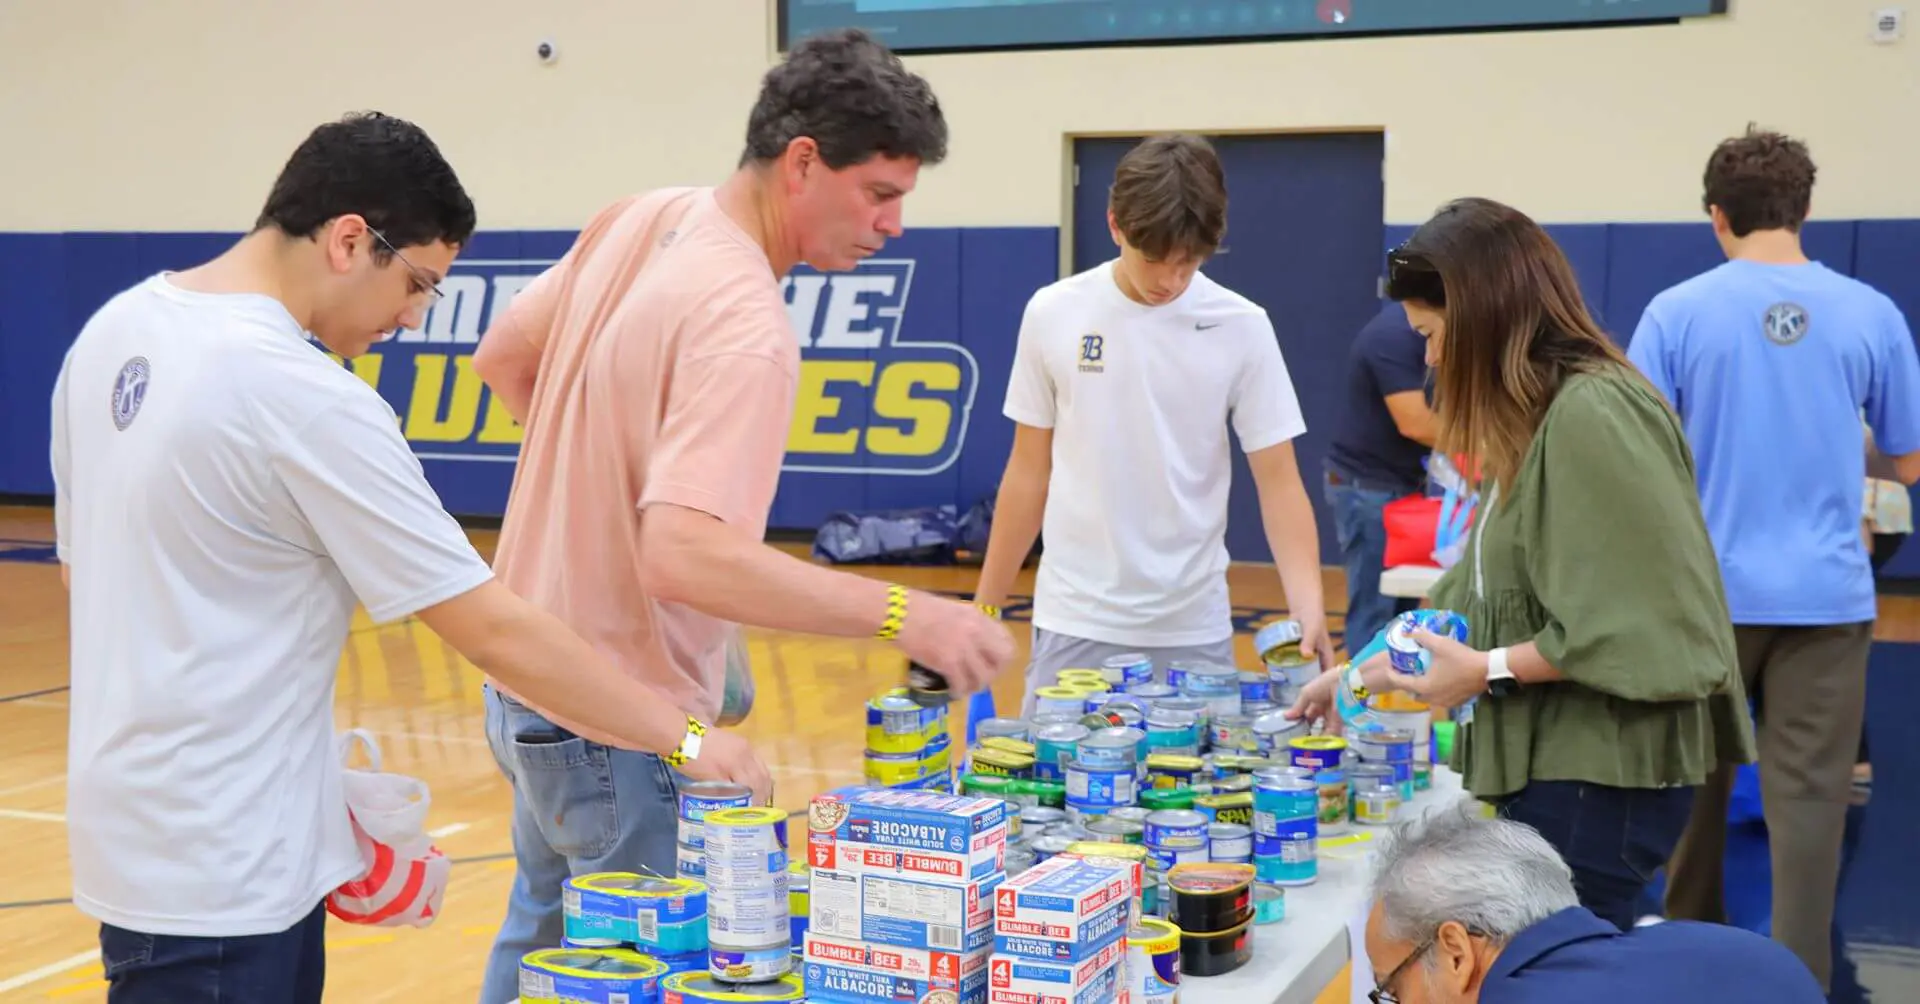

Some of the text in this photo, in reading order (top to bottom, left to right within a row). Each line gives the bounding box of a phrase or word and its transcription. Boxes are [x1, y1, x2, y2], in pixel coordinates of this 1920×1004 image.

[779, 275, 895, 348] HE
[1081, 335, 1103, 361] B
[785, 361, 961, 456] ES
[872, 820, 946, 840] ALBACORE
[816, 850, 829, 866] 4
[867, 852, 958, 874] BUMBLE BEE
[968, 886, 977, 902] 4
[999, 892, 1012, 906] 4
[1000, 922, 1067, 937] BUMBLE BEE
[813, 943, 899, 968] BUMBLE BEE
[1006, 942, 1054, 957] ALBACORE
[936, 955, 951, 970] 4
[994, 962, 1007, 977] 4
[824, 976, 894, 998] ALBACORE
[995, 991, 1033, 1004] BUMBLE
